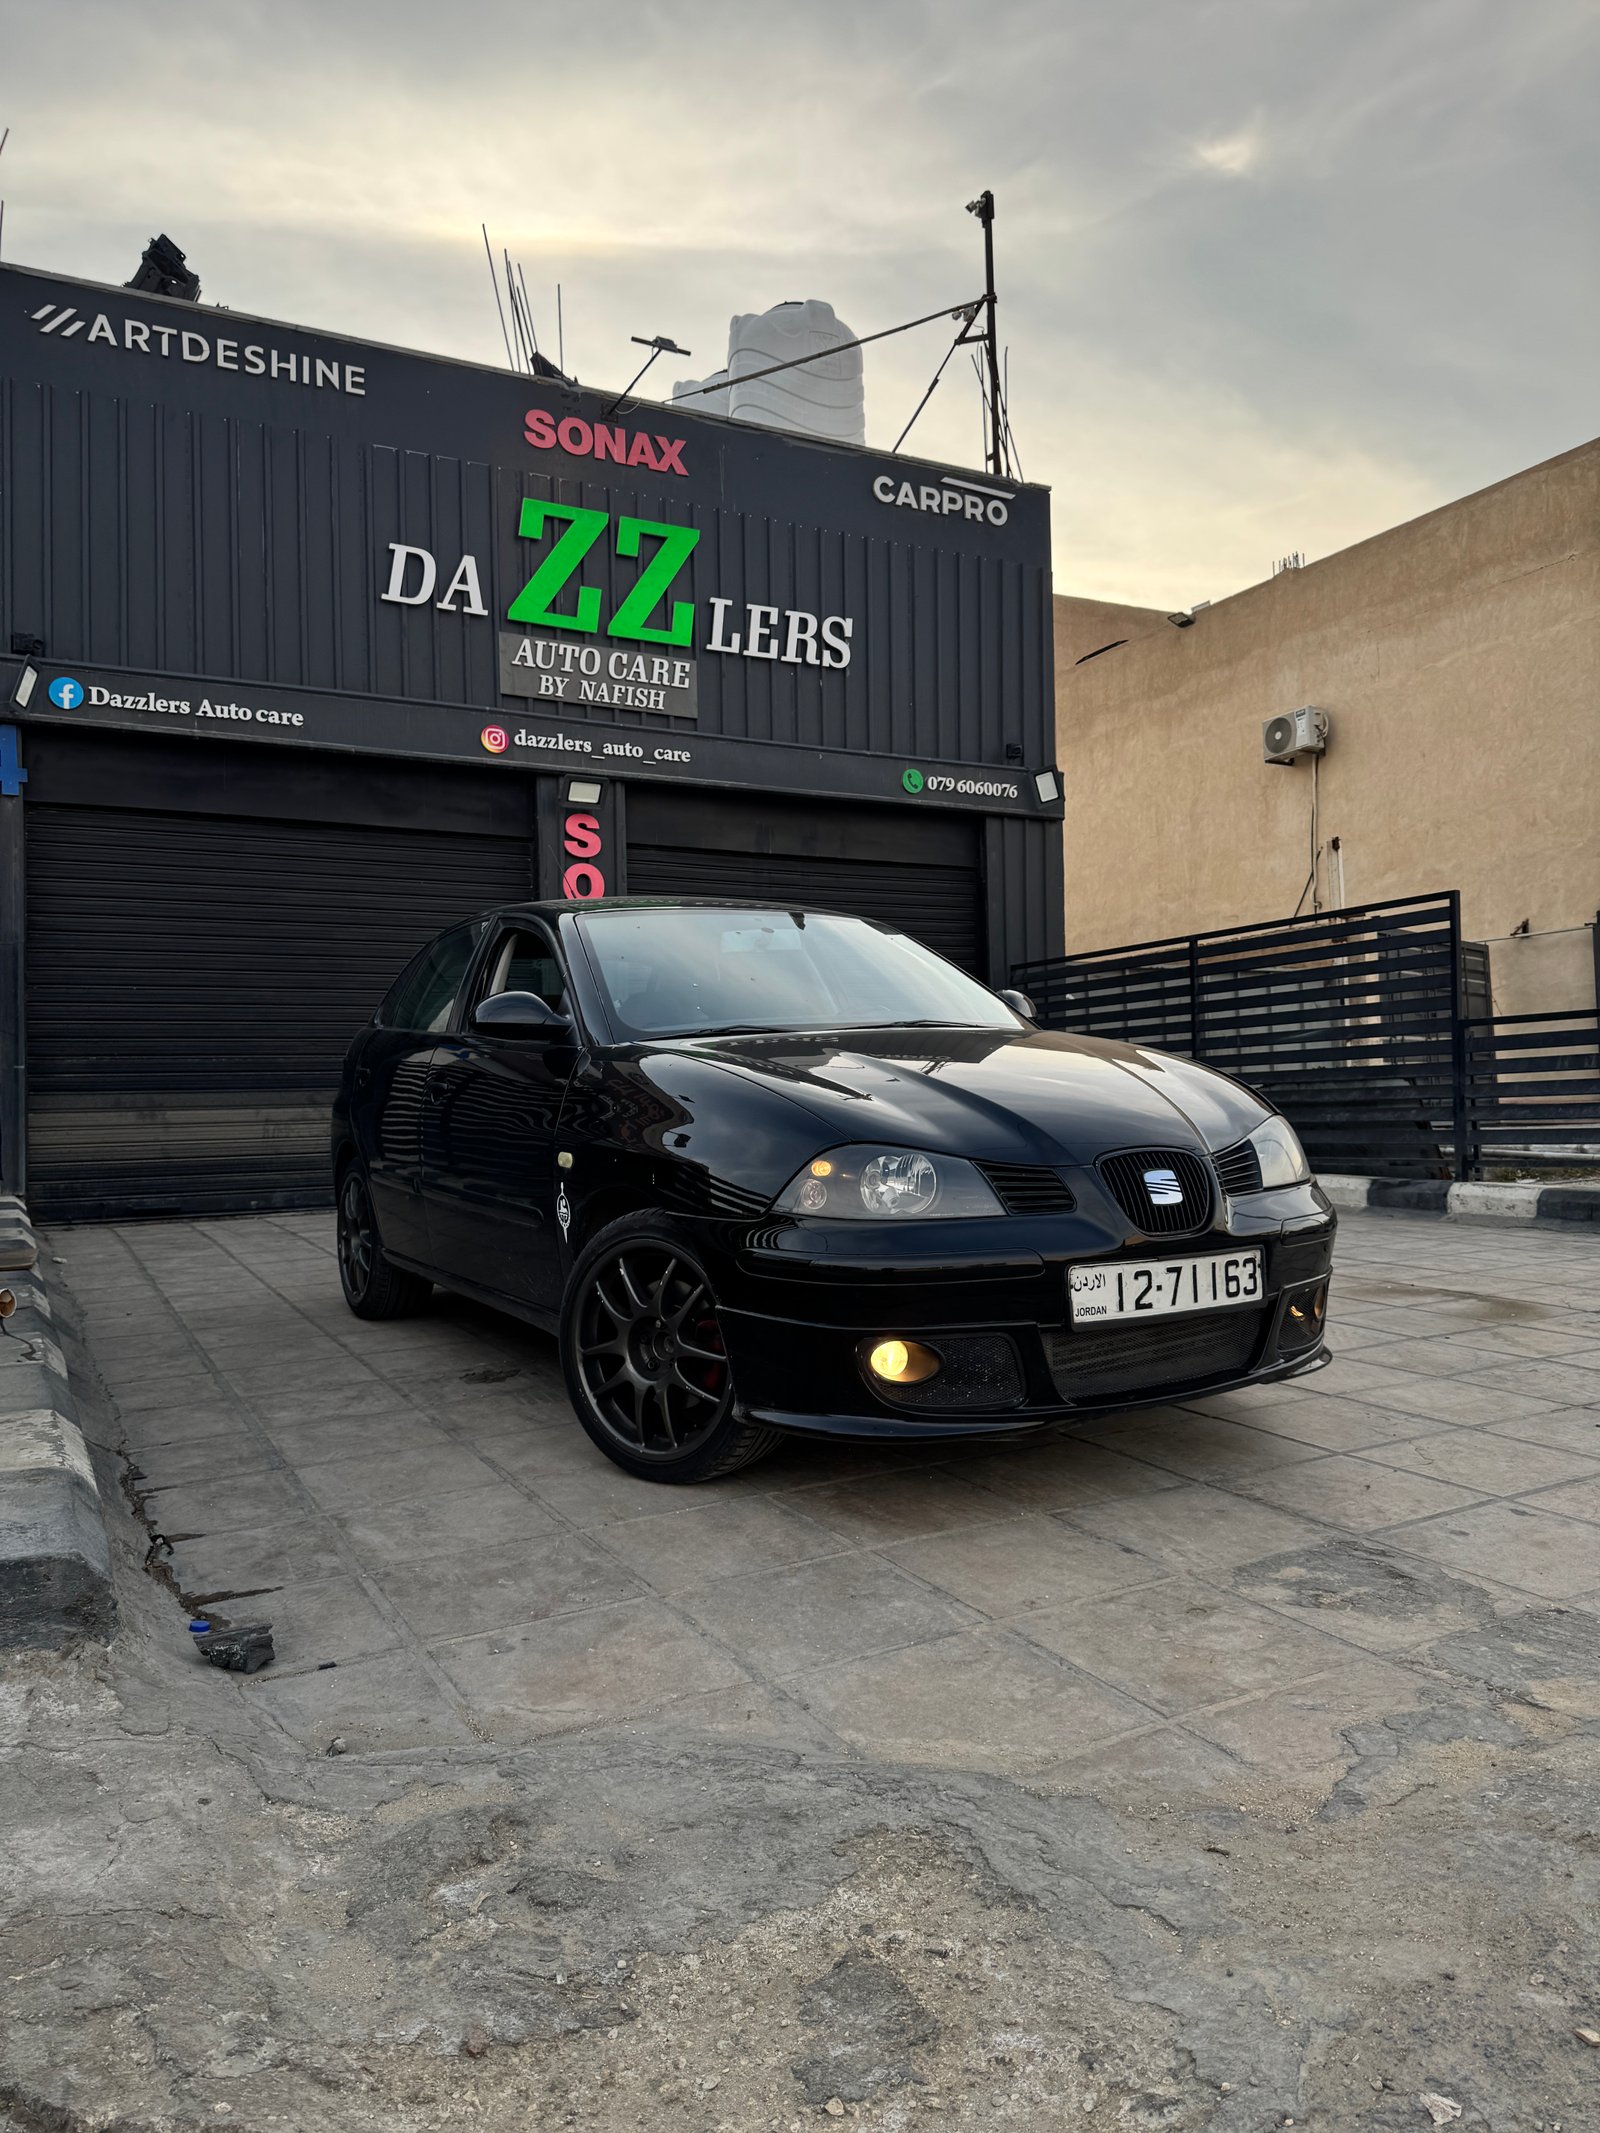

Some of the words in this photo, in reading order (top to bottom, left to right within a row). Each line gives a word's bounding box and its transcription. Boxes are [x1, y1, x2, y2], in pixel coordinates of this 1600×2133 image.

[88, 313, 366, 396] ARTDESHINE
[523, 409, 689, 476] SONAX
[873, 475, 1009, 526] CARPRO
[511, 638, 601, 676] AUTO
[607, 651, 691, 689] CARE
[88, 686, 191, 715] Dazzlers
[195, 698, 252, 721] Auto
[255, 708, 304, 726] care
[538, 674, 570, 697] BY
[578, 680, 666, 710] NAFISH
[1075, 1305, 1107, 1317] JORDAN
